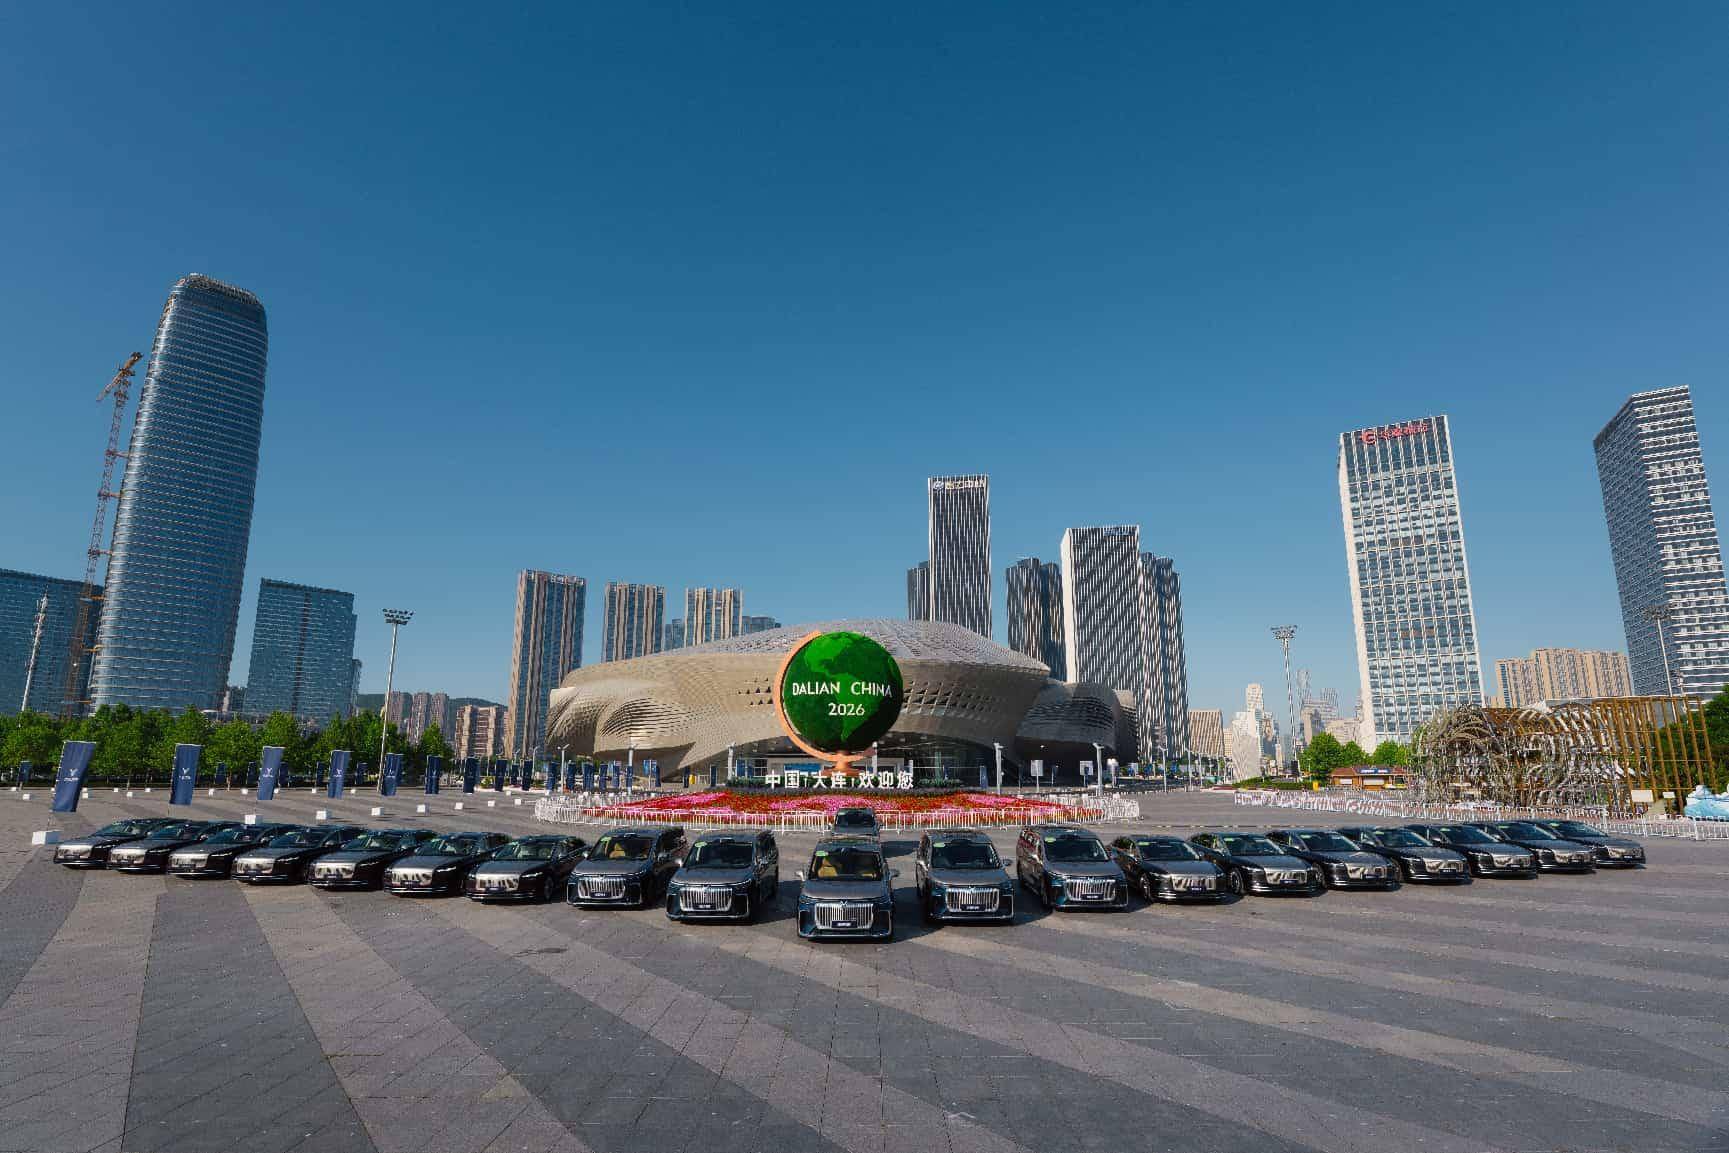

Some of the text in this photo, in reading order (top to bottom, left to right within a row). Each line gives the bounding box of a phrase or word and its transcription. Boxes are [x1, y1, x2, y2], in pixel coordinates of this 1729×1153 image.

[792, 681, 893, 698] DALIAN CHINA
[828, 702, 866, 716] 2026
